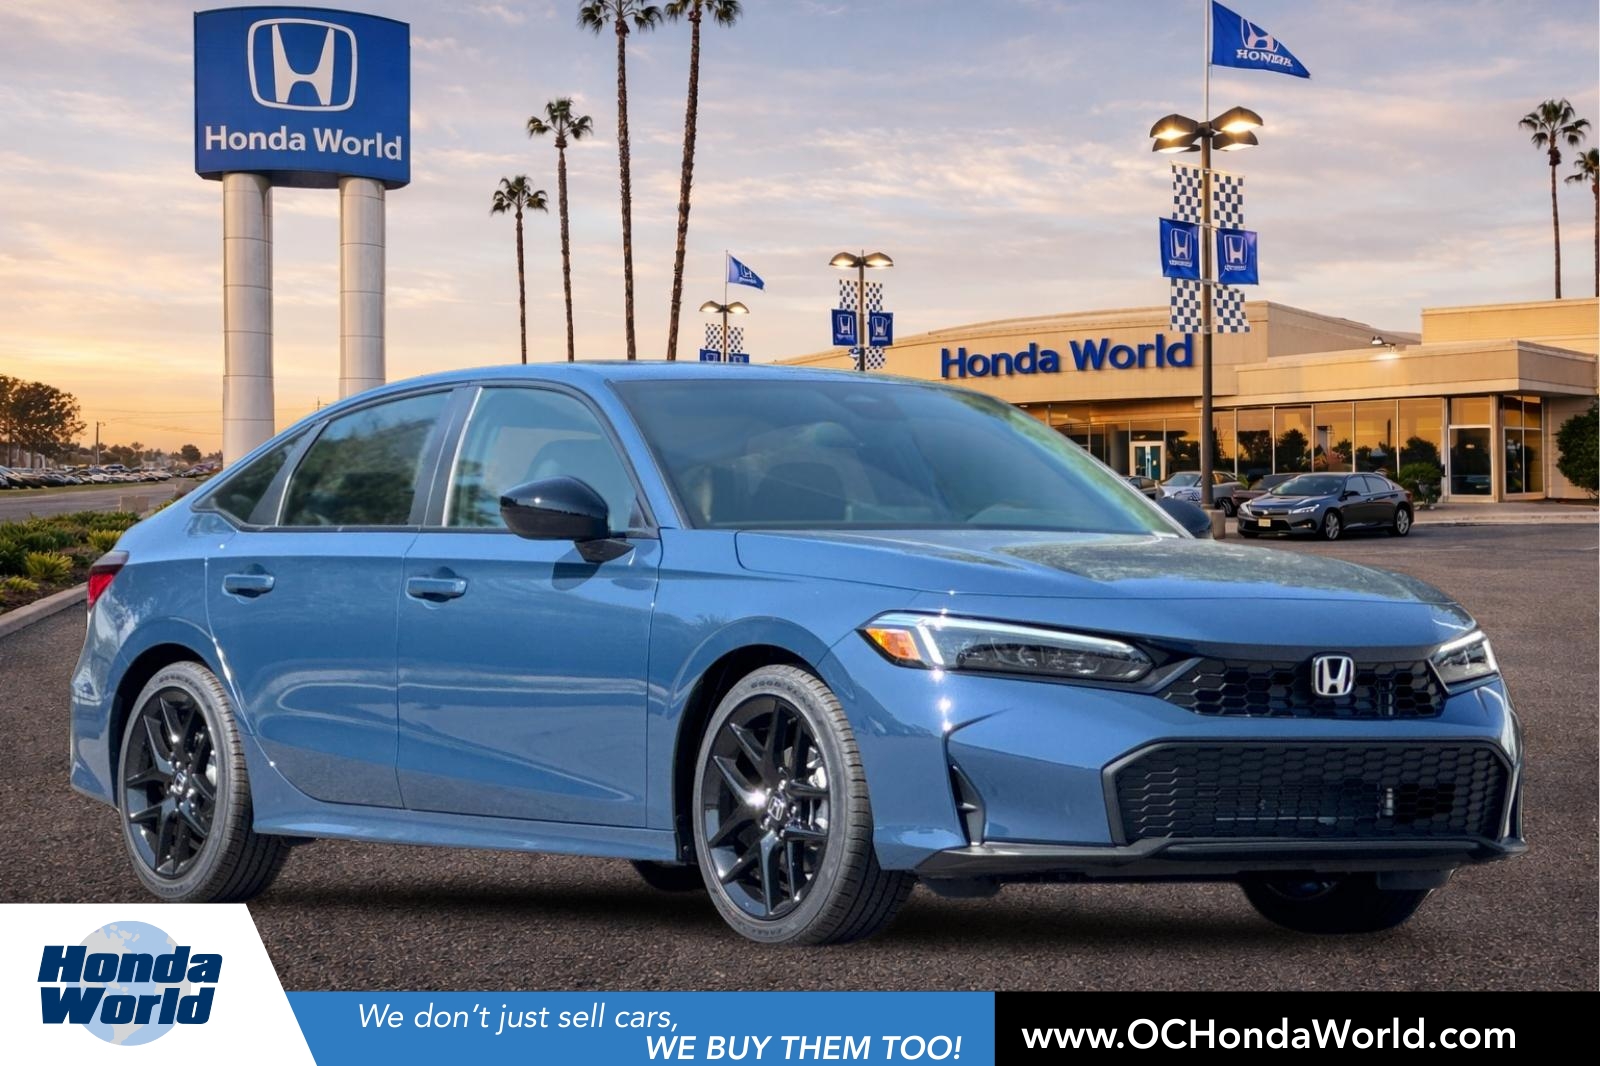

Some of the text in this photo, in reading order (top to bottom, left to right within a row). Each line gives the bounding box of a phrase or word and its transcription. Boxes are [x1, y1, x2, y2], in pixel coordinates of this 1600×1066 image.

[205, 125, 402, 161] Honda World
[941, 334, 1194, 377] Honda World
